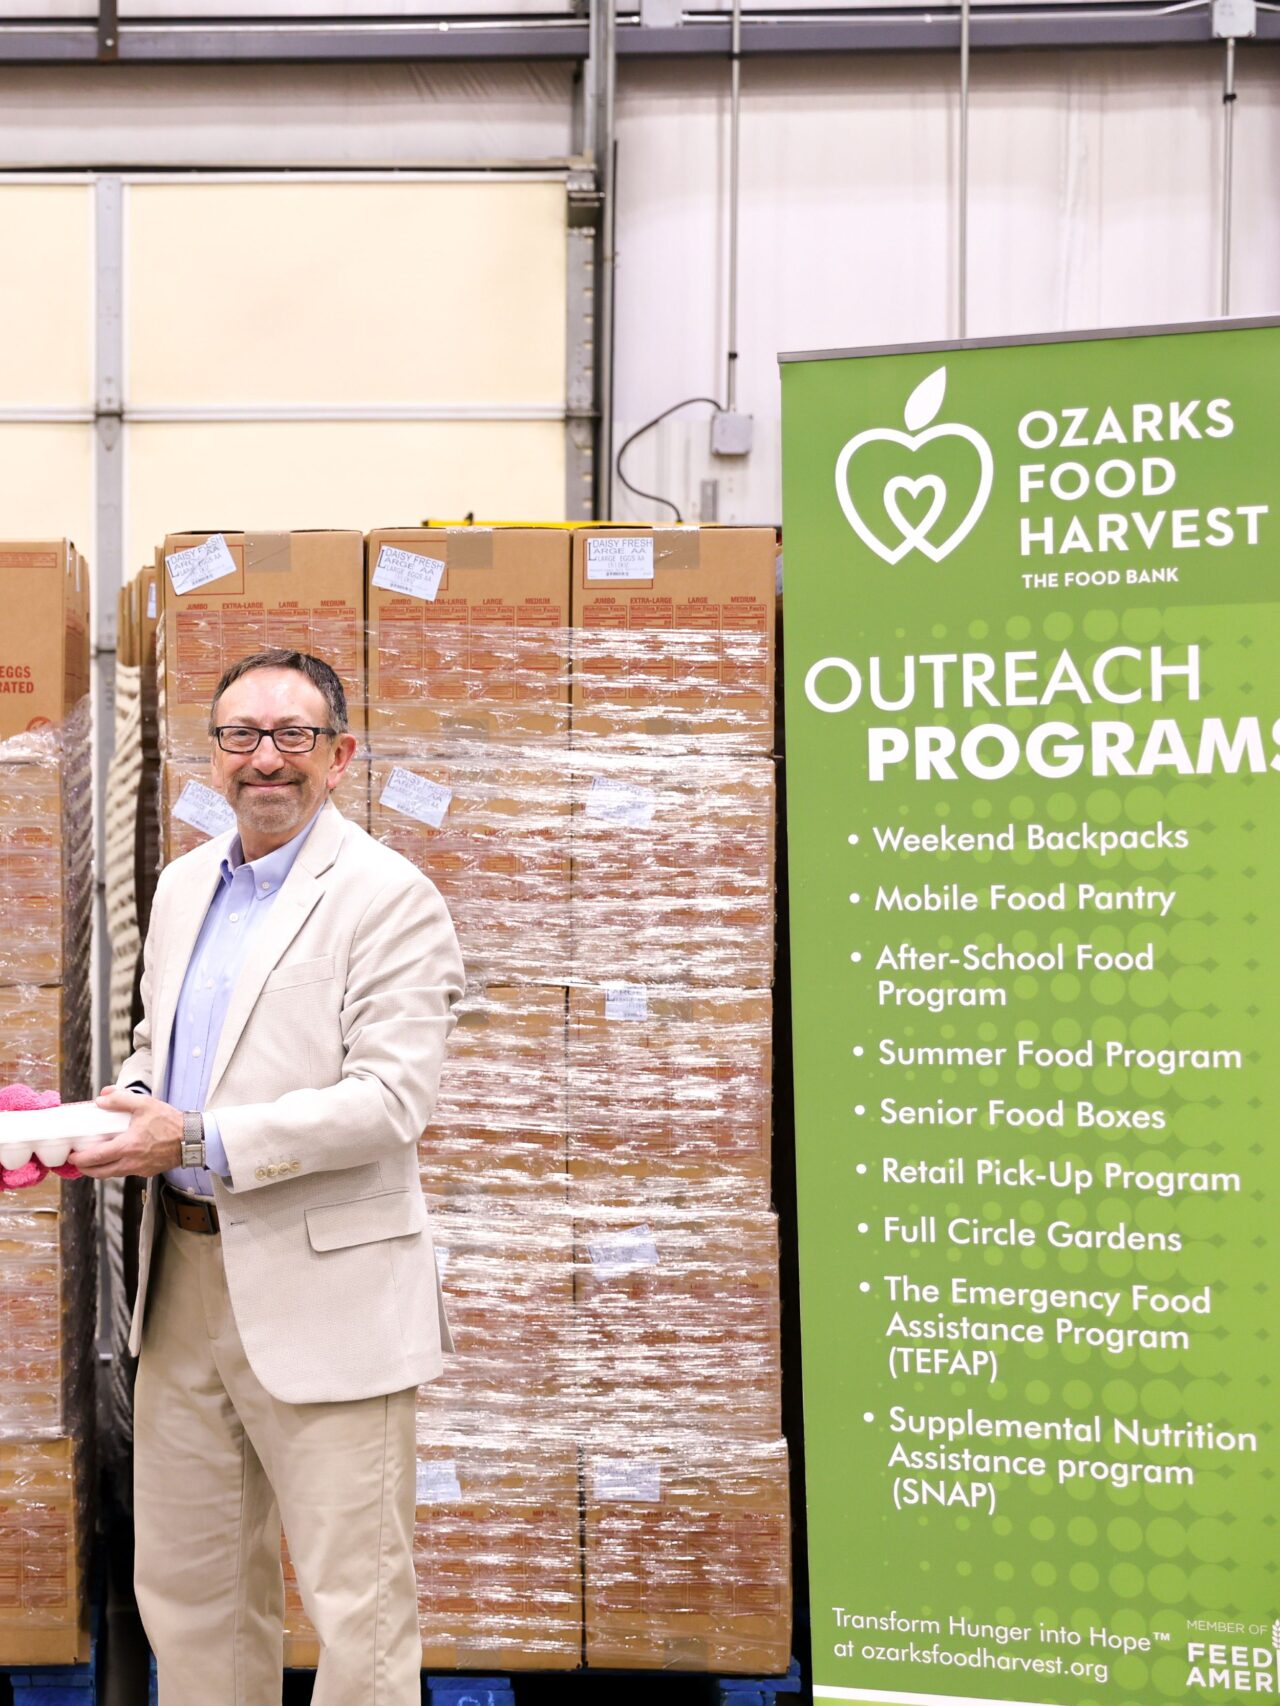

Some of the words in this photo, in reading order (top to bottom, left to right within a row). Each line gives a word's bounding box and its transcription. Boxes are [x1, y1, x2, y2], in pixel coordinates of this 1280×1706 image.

[1018, 399, 1233, 449] OZARKS
[1020, 457, 1176, 502] FOOD
[592, 540, 619, 548] DAISY
[622, 539, 652, 548] FRESH
[1021, 505, 1268, 555] HARVEST
[170, 550, 196, 564] DAISY
[385, 548, 412, 561] DAISY
[414, 556, 443, 570] FRESH
[1022, 573, 1058, 588] THE
[1065, 571, 1120, 586] FOOD
[1126, 568, 1178, 584] BANK
[222, 602, 264, 610] EXTRA-LARGE
[278, 601, 299, 609] LARGE
[0, 666, 32, 678] EGGS
[805, 645, 1199, 712] OUTREACH
[873, 824, 1014, 852] Weekend
[1028, 821, 1188, 855] Backpacks
[875, 884, 978, 911] Mobile
[991, 883, 1065, 910] Food
[1079, 884, 1175, 916] Pantry
[876, 944, 1063, 970] After-School
[1077, 943, 1153, 970] Food
[879, 980, 1006, 1012] Program
[880, 1039, 1007, 1065] Summer
[1019, 1040, 1092, 1067] Food
[1107, 1042, 1241, 1075] Program
[881, 1098, 977, 1124] Senior
[989, 1100, 1063, 1126] Food
[1078, 1102, 1165, 1129] Boxes
[883, 1158, 963, 1184] Retail
[977, 1159, 1092, 1194] Pick-Up
[1106, 1163, 1240, 1197] Program
[885, 1216, 935, 1242] Full
[948, 1218, 1035, 1246] Circle
[1048, 1221, 1182, 1251] Gardens
[884, 1275, 939, 1302] The
[952, 1278, 1120, 1316] Emergency
[1133, 1285, 1210, 1313] Food
[886, 1312, 1043, 1343] Assistance
[1057, 1318, 1188, 1353] Program
[889, 1347, 997, 1383] (TEFAP)
[890, 1406, 1100, 1442] Supplemental
[1115, 1419, 1256, 1451] Nutrition
[888, 1443, 1045, 1475] Assistance
[1059, 1460, 1193, 1488] program
[894, 1478, 995, 1515] (SNAP)
[832, 1608, 939, 1633] Transform
[950, 1616, 1031, 1644] Hunger
[1040, 1623, 1081, 1645] into
[1187, 1620, 1245, 1633] MEMBER
[1249, 1624, 1267, 1635] OF
[834, 1641, 854, 1656] at
[862, 1643, 1107, 1682] ozarksfoodharvest.org
